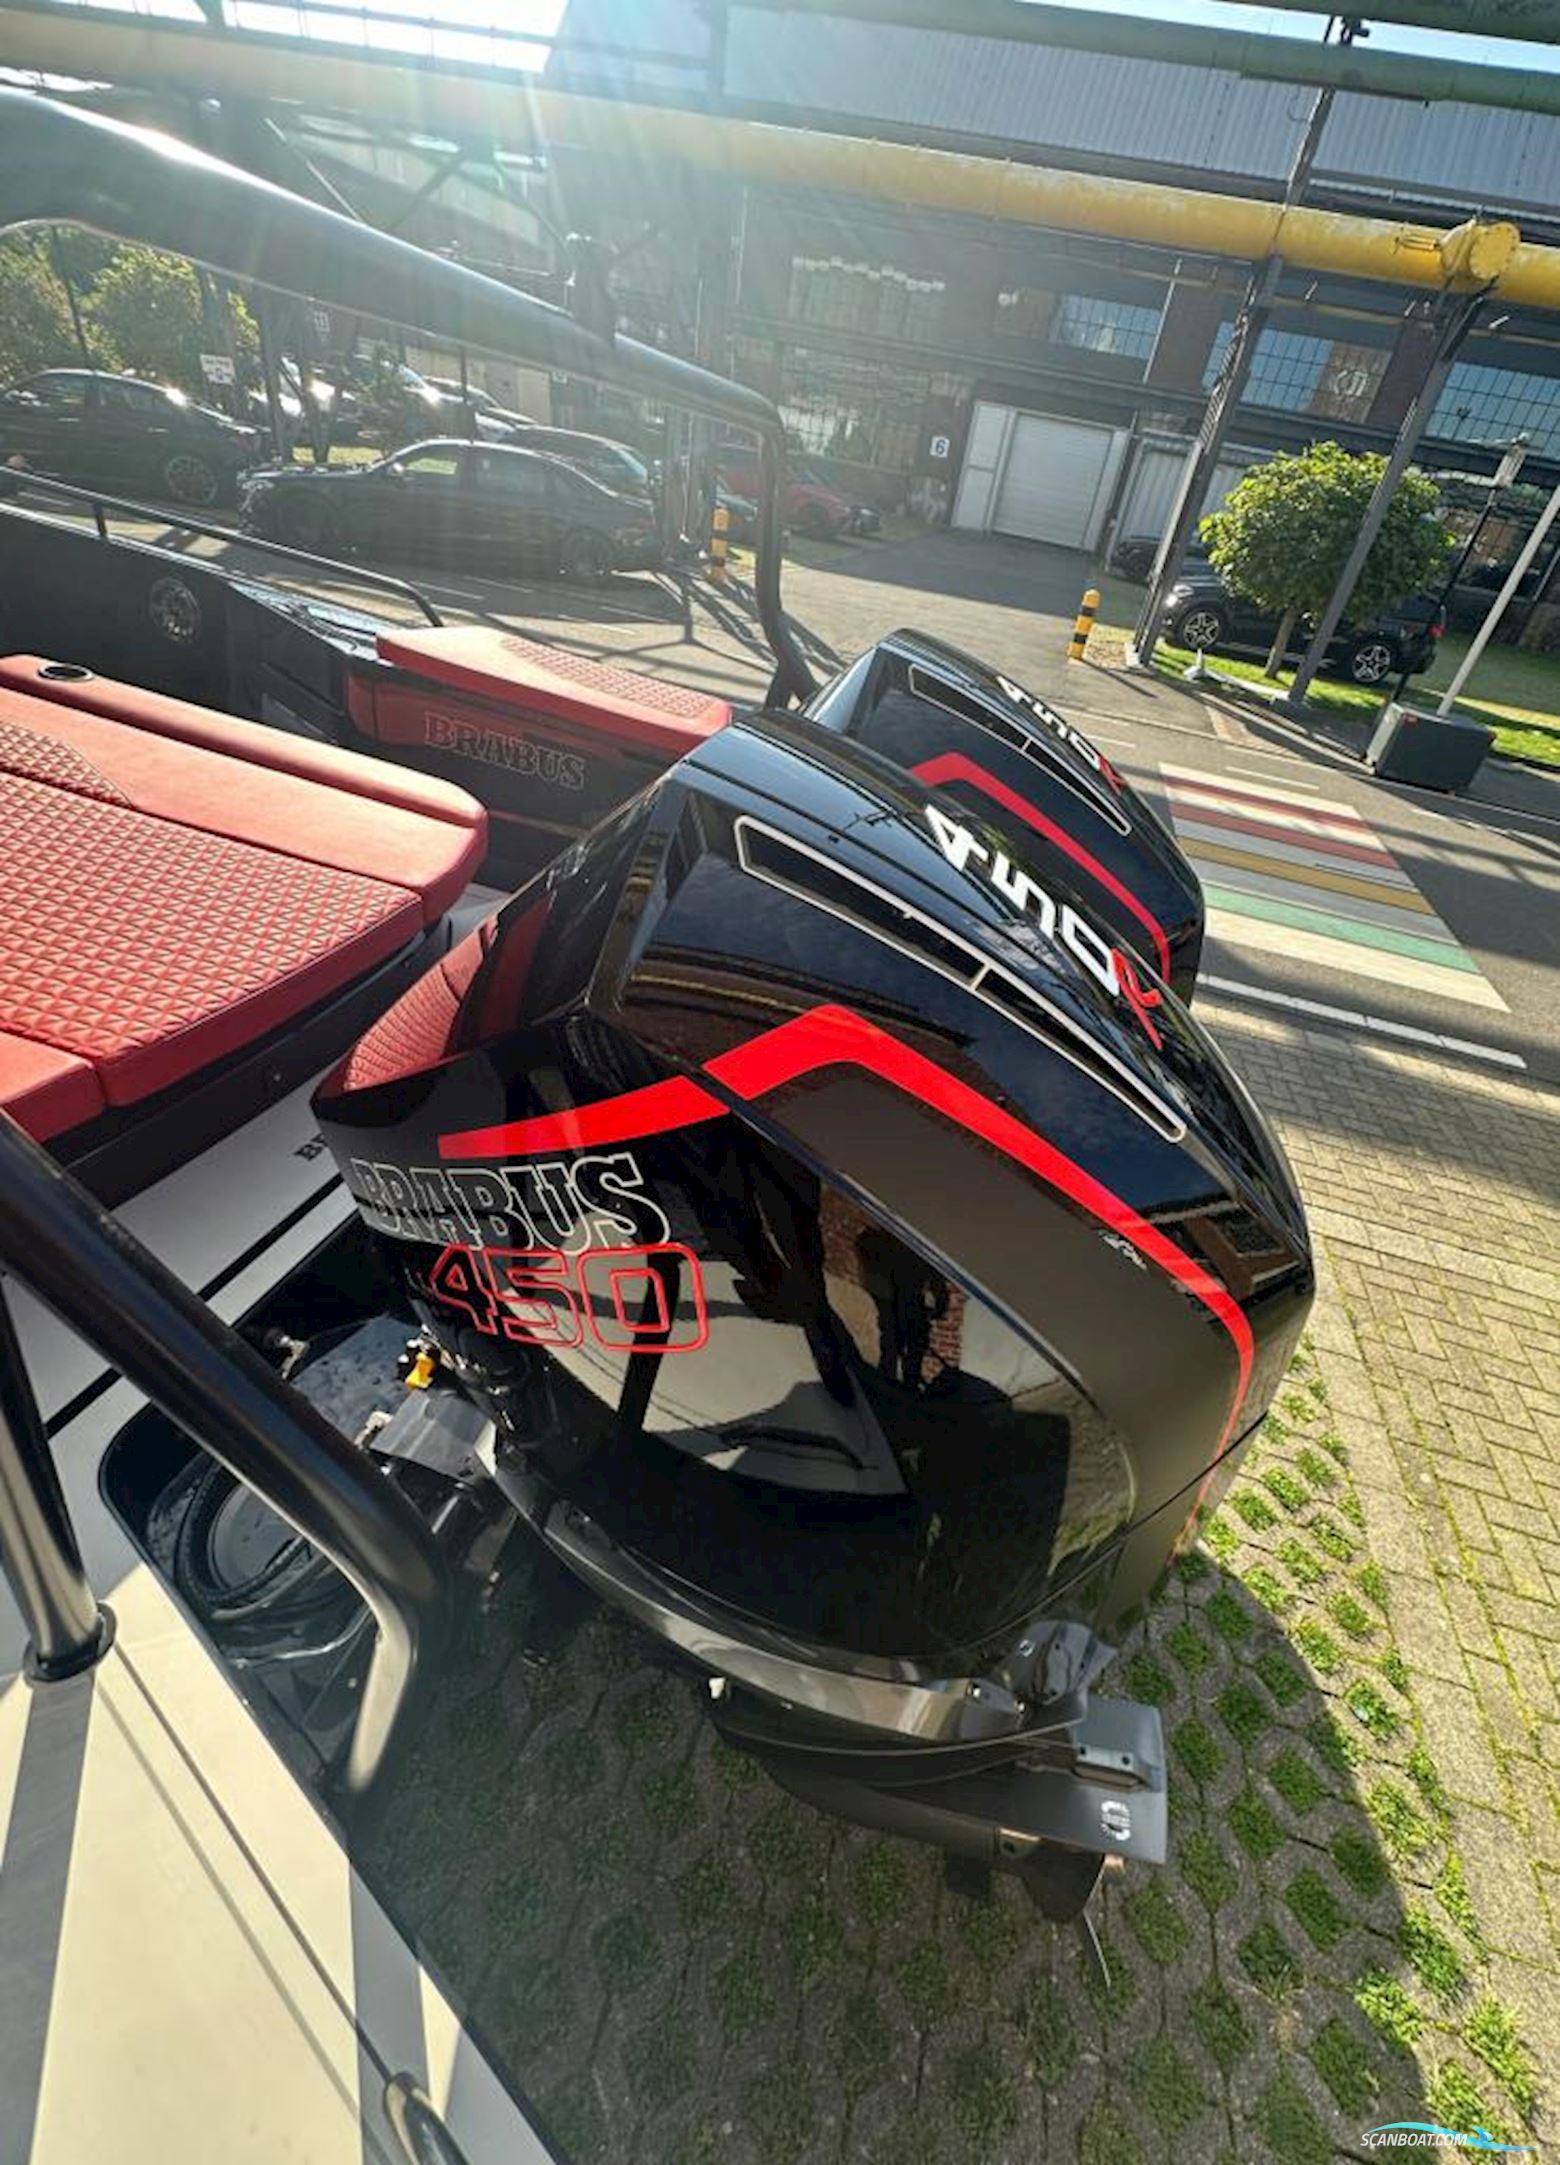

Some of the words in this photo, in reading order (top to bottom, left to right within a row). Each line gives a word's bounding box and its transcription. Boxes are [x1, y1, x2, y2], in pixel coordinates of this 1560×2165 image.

[424, 711, 586, 791] BRABUS
[350, 1151, 671, 1256] BRABUS
[427, 1242, 709, 1354] 450
